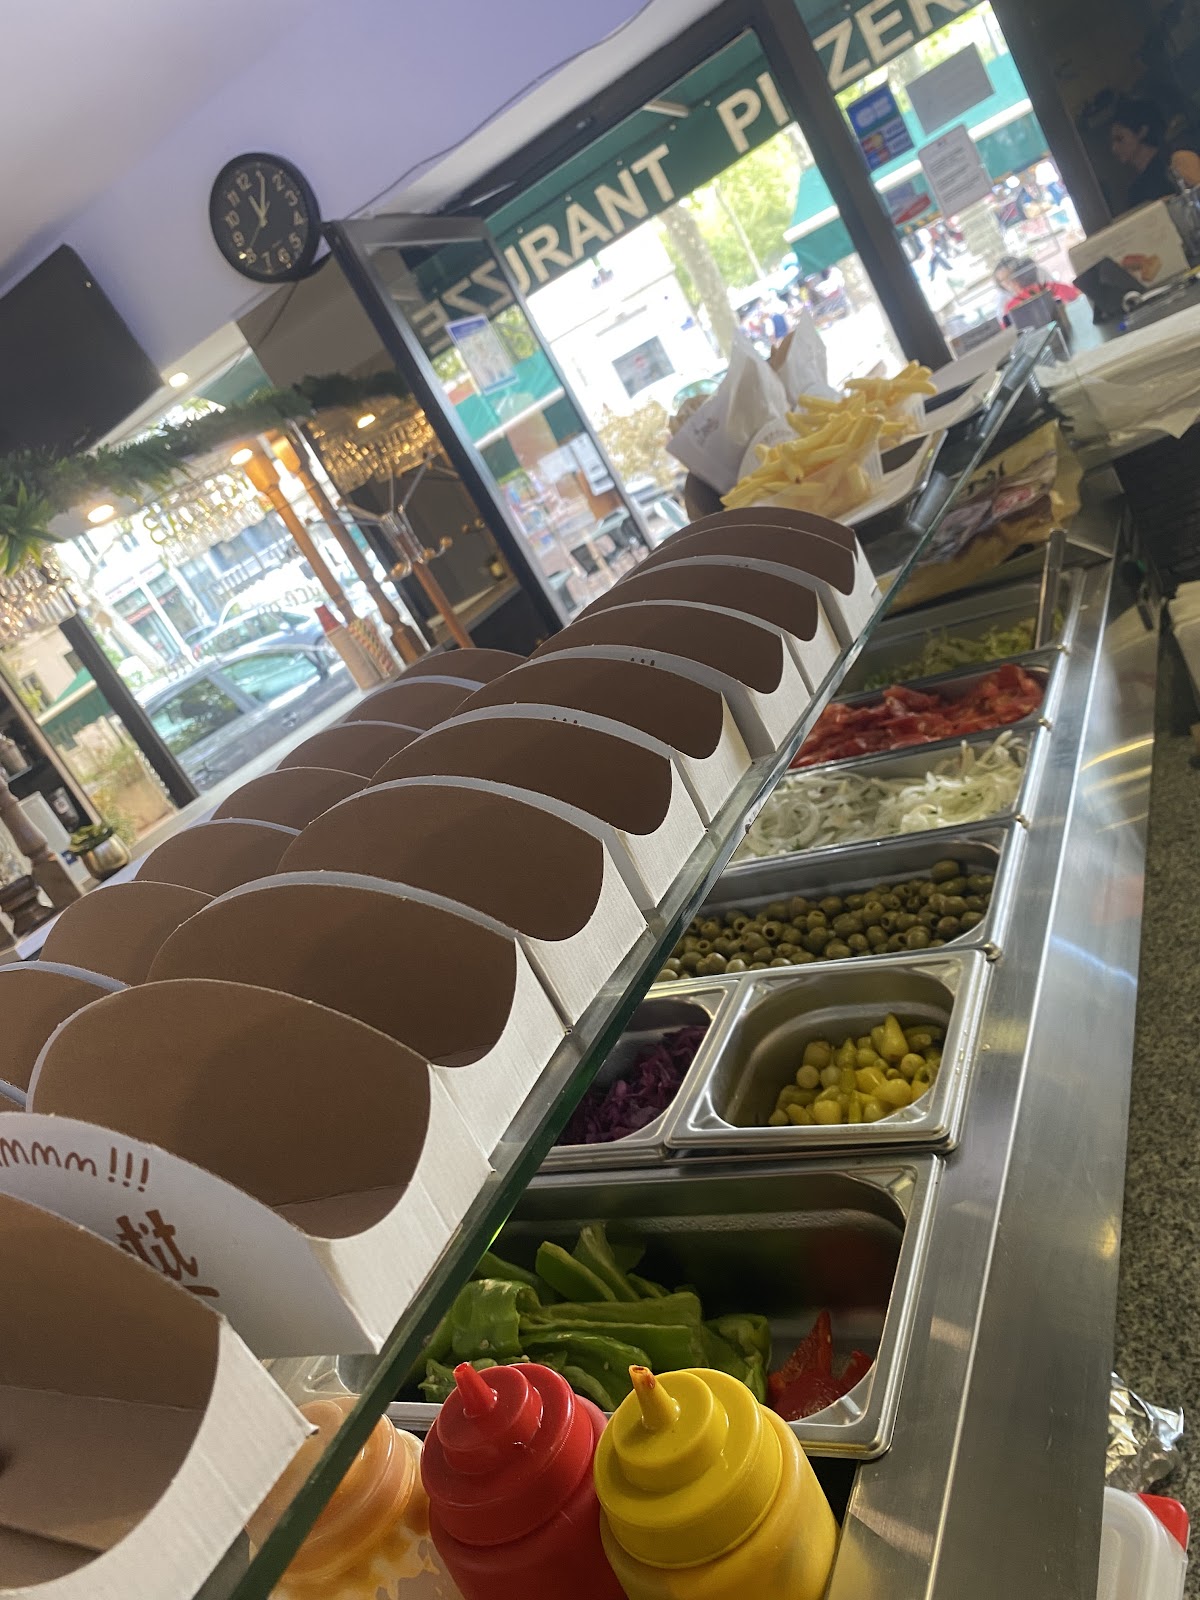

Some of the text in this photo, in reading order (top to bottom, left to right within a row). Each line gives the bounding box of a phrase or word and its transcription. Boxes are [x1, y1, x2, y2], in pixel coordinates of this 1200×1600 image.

[235, 170, 252, 192] 12
[271, 172, 286, 192] 2
[284, 189, 299, 207] 3
[225, 208, 240, 228] 10
[293, 210, 305, 226] 4
[232, 230, 245, 248] 9
[288, 231, 302, 249] 5
[261, 250, 272, 272] 7
[277, 246, 291, 264] 6
